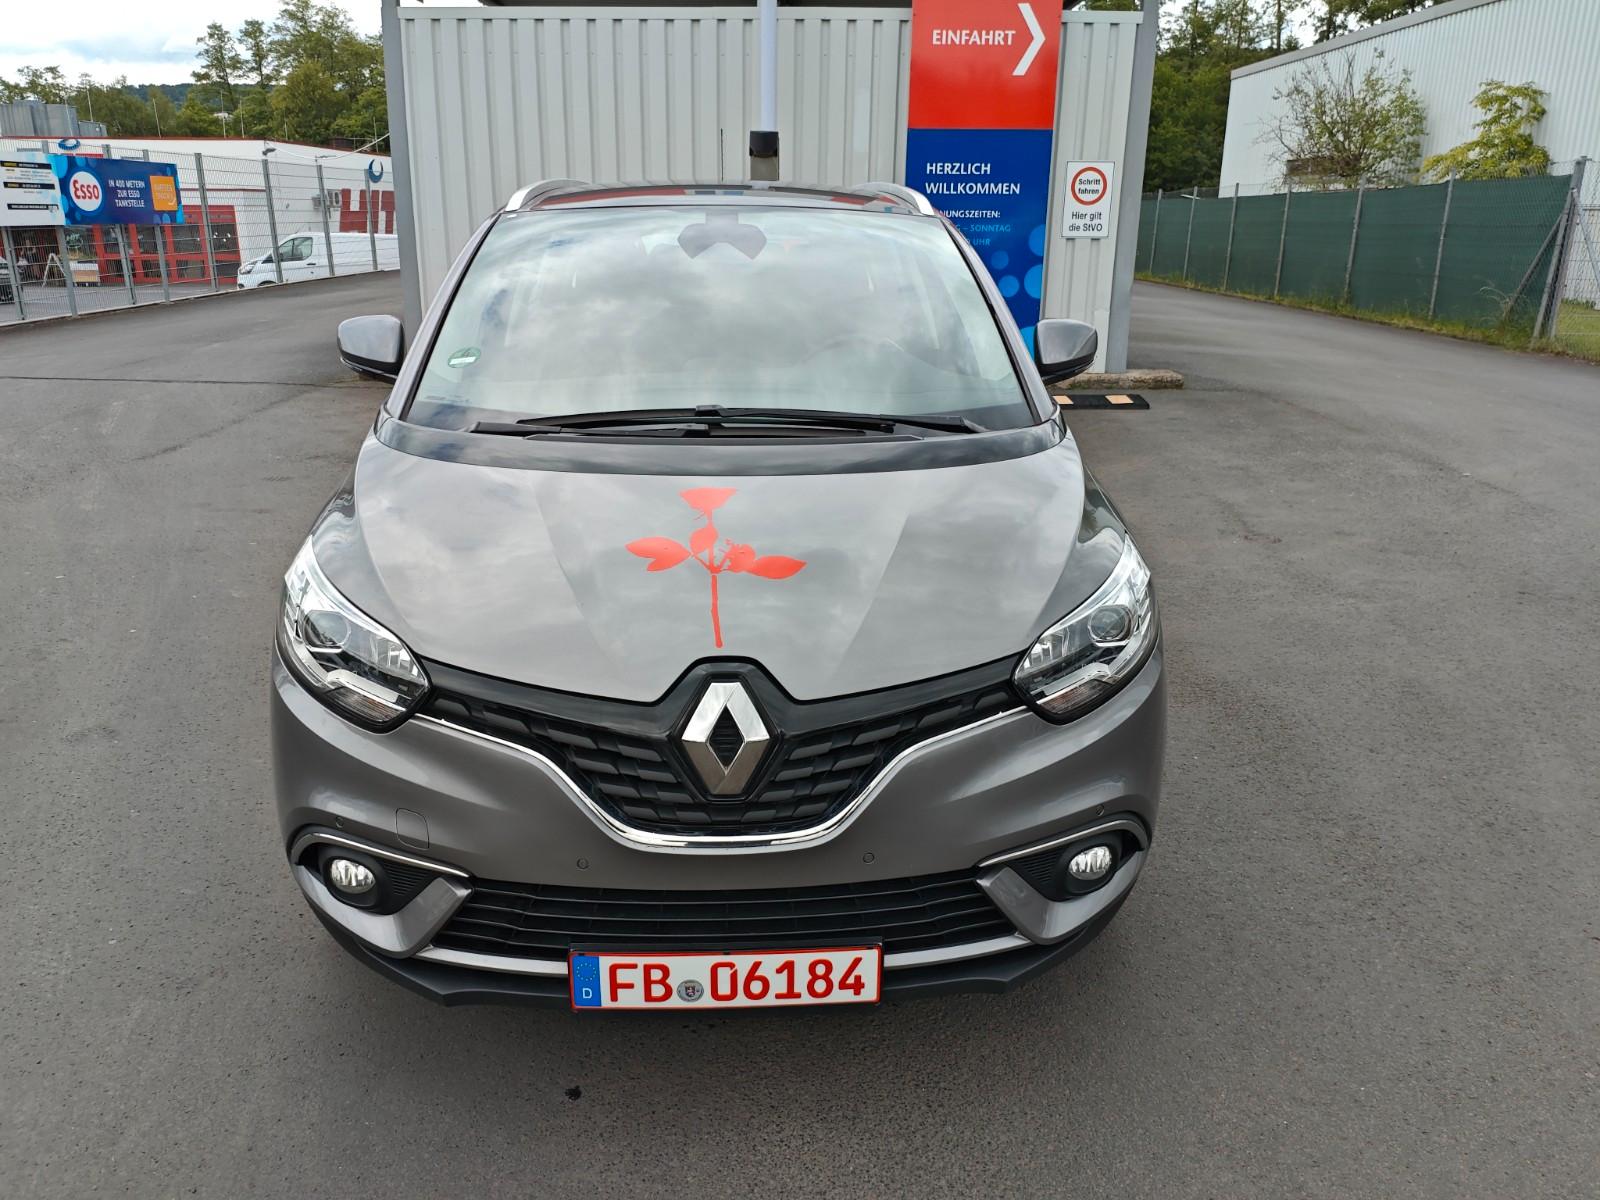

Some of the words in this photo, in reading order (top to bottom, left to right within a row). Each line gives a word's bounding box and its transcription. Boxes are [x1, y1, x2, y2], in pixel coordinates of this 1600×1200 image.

[932, 29, 1016, 46] EINFAHRT
[926, 162, 991, 175] HERZLICH
[125, 180, 145, 188] METERN
[925, 182, 1020, 195] WILLKOMMEN
[117, 189, 128, 198] ZUR
[128, 190, 140, 198] ESSO
[1078, 187, 1100, 195] fahren
[115, 199, 145, 208] TANKSTELLE
[1071, 211, 1087, 220] Hier
[1089, 211, 1102, 222] gilt
[970, 225, 1012, 233] SONNTAG
[1068, 223, 1081, 232] die
[1083, 223, 1103, 232] StVO
[973, 238, 991, 246] UHR
[609, 963, 673, 1002] FB
[710, 956, 866, 1002] 06184
[582, 987, 593, 1000] D
